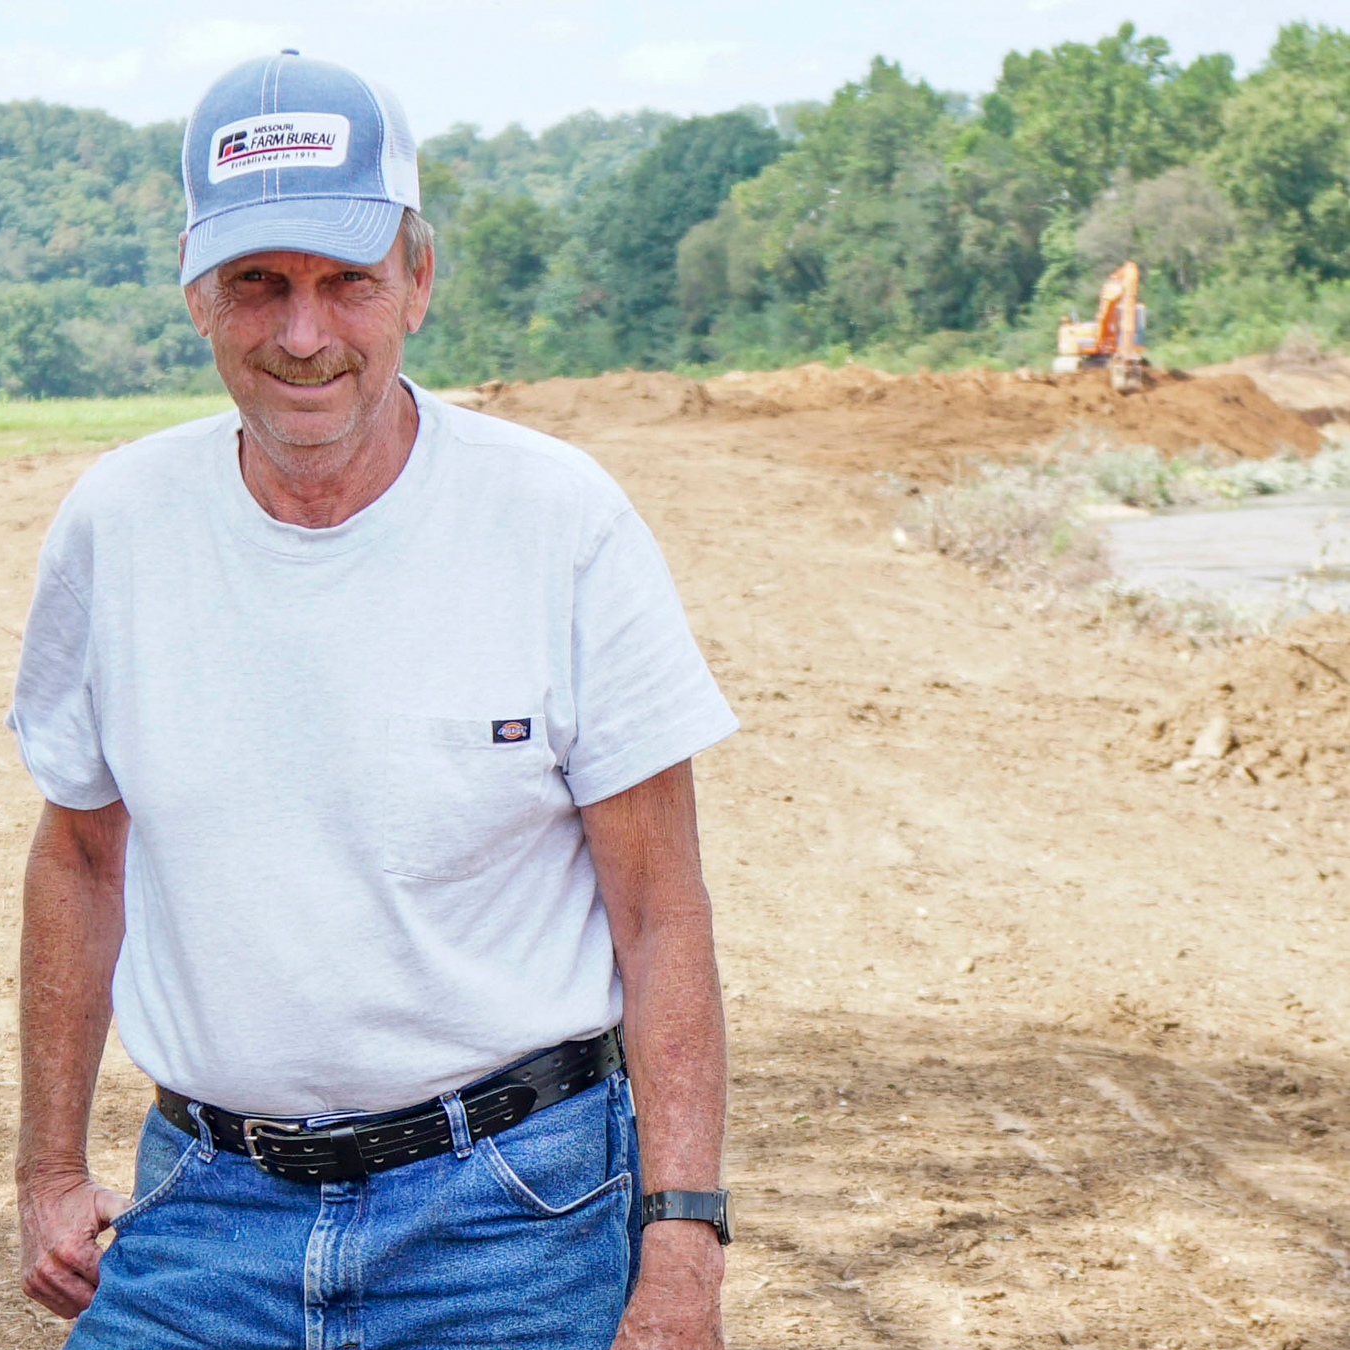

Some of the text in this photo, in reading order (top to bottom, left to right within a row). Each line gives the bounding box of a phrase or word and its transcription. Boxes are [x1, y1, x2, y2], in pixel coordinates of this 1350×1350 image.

[254, 124, 293, 134] MISSOURI
[250, 132, 335, 149] FARM BUREAU
[231, 153, 278, 169] Established
[281, 151, 290, 159] in
